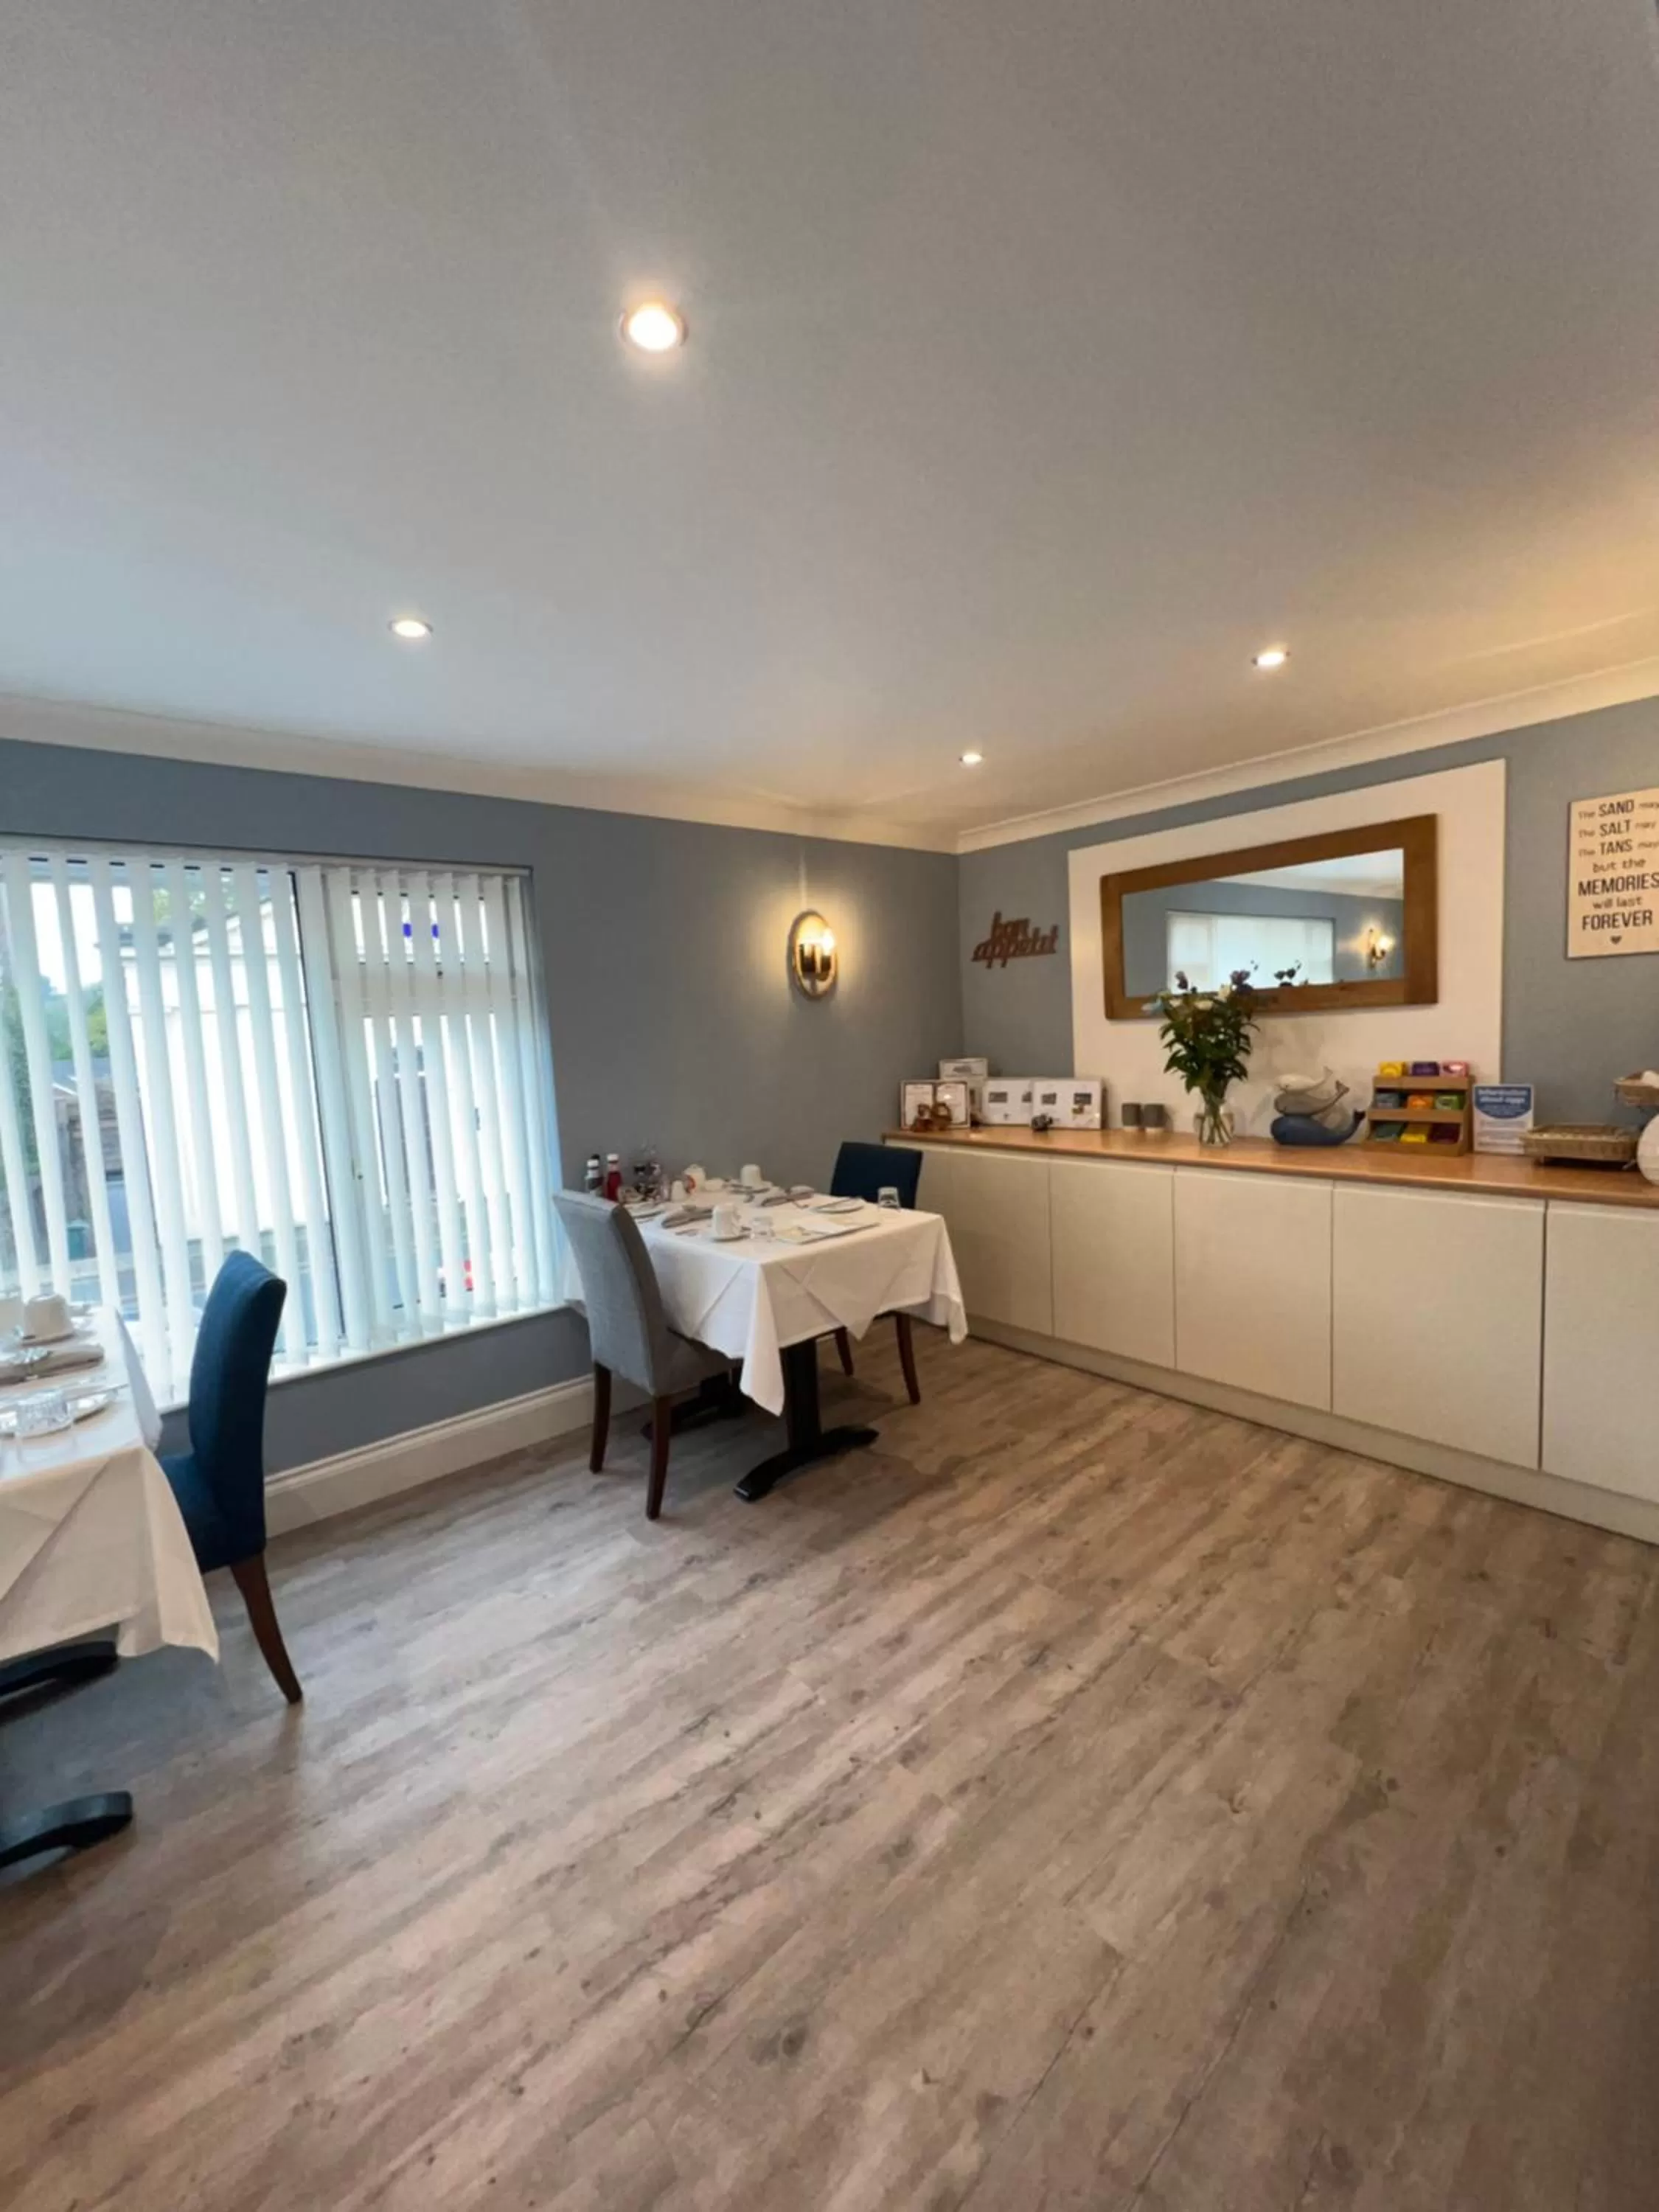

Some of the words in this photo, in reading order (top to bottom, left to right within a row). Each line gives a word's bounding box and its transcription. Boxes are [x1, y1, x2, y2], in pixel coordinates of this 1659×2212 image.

[1598, 799, 1635, 817] SAND
[1599, 819, 1631, 837] SALT
[1599, 838, 1633, 855] TANS
[1593, 862, 1616, 873] but
[1622, 858, 1646, 869] the
[1578, 872, 1659, 897] MEMORIES
[1593, 898, 1613, 909] will
[1616, 896, 1642, 908] last
[1582, 908, 1653, 931] FOREVER
